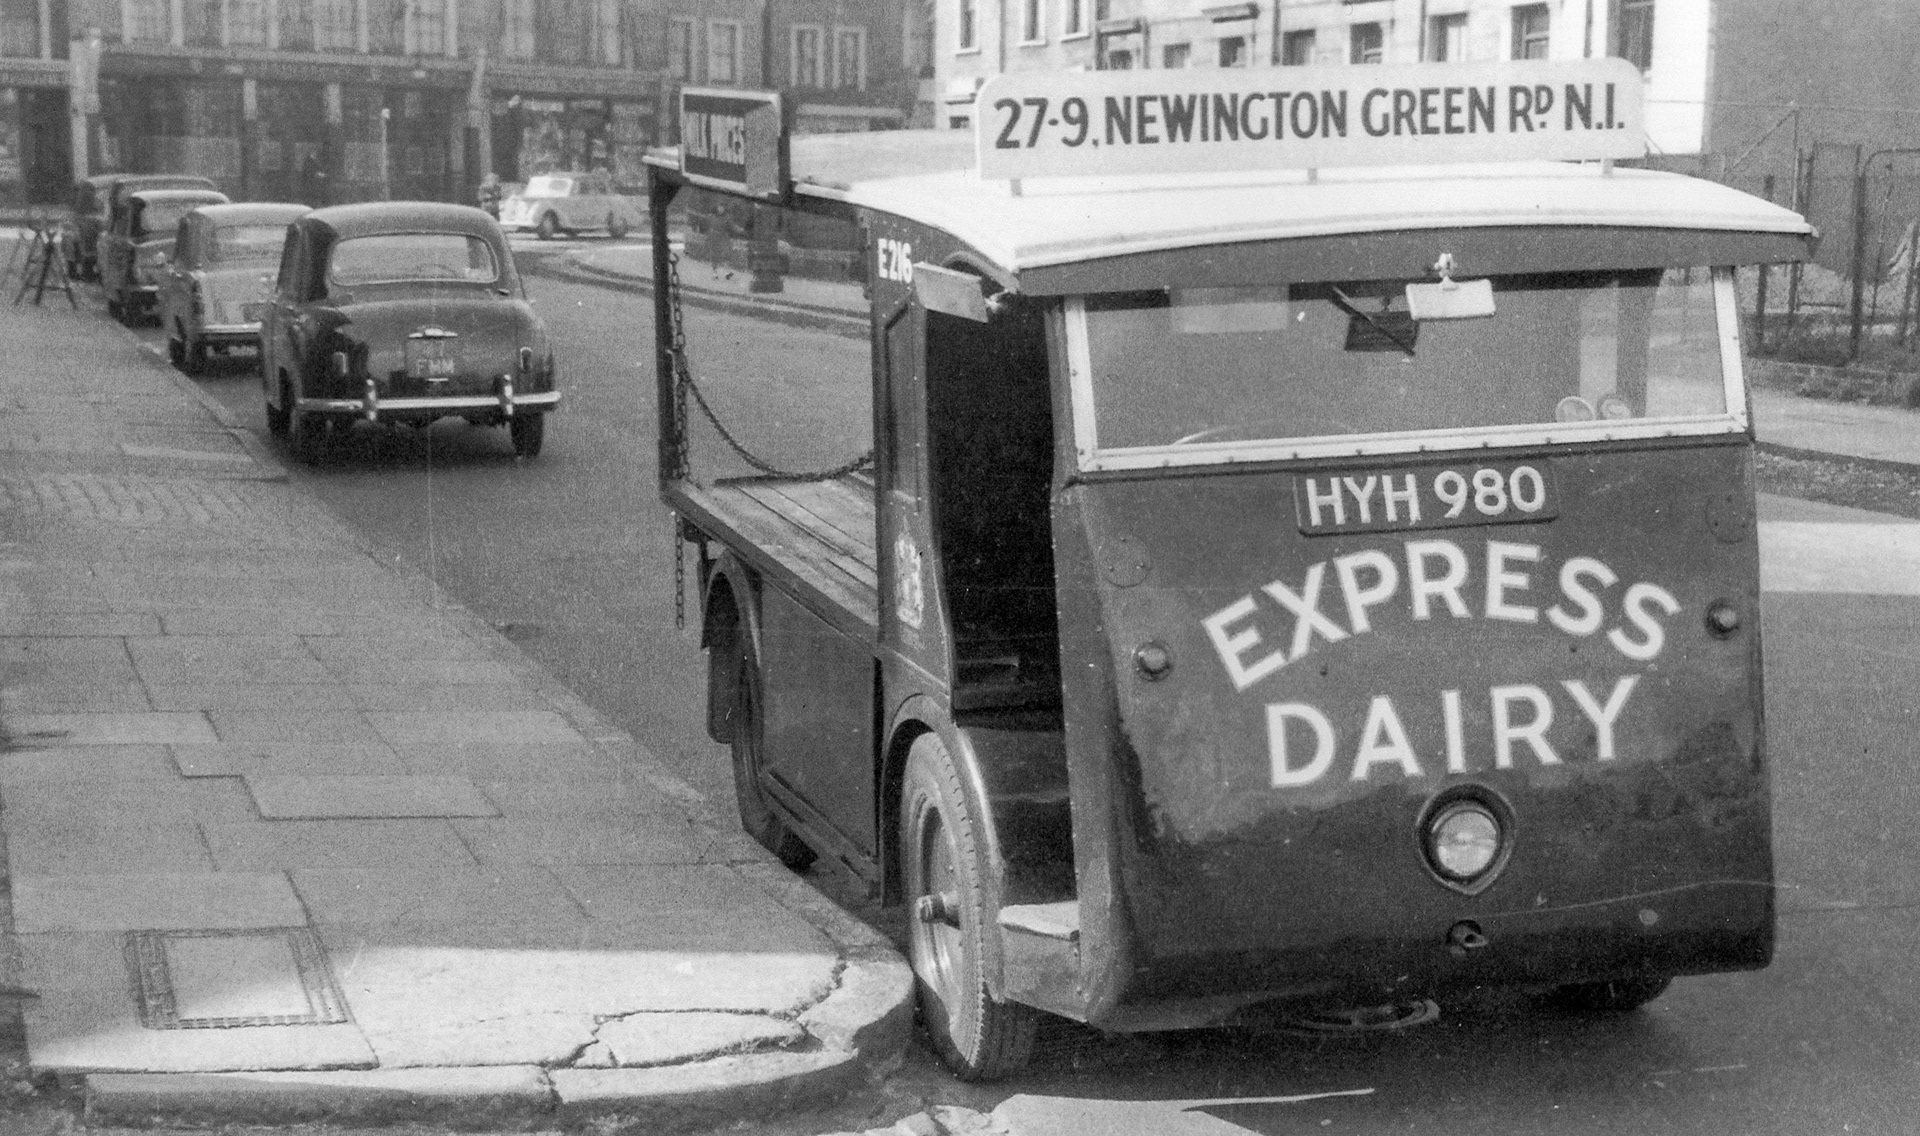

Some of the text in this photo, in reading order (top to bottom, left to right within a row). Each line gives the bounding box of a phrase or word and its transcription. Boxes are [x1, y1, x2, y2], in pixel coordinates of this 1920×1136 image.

[1103, 89, 1348, 146] NEWINGTON
[1360, 85, 1496, 138] GREEN
[877, 237, 912, 284] E216
[1305, 464, 1546, 527] HYH 980
[1201, 538, 1683, 692] EXPRESS
[1265, 674, 1640, 788] DAIRY
